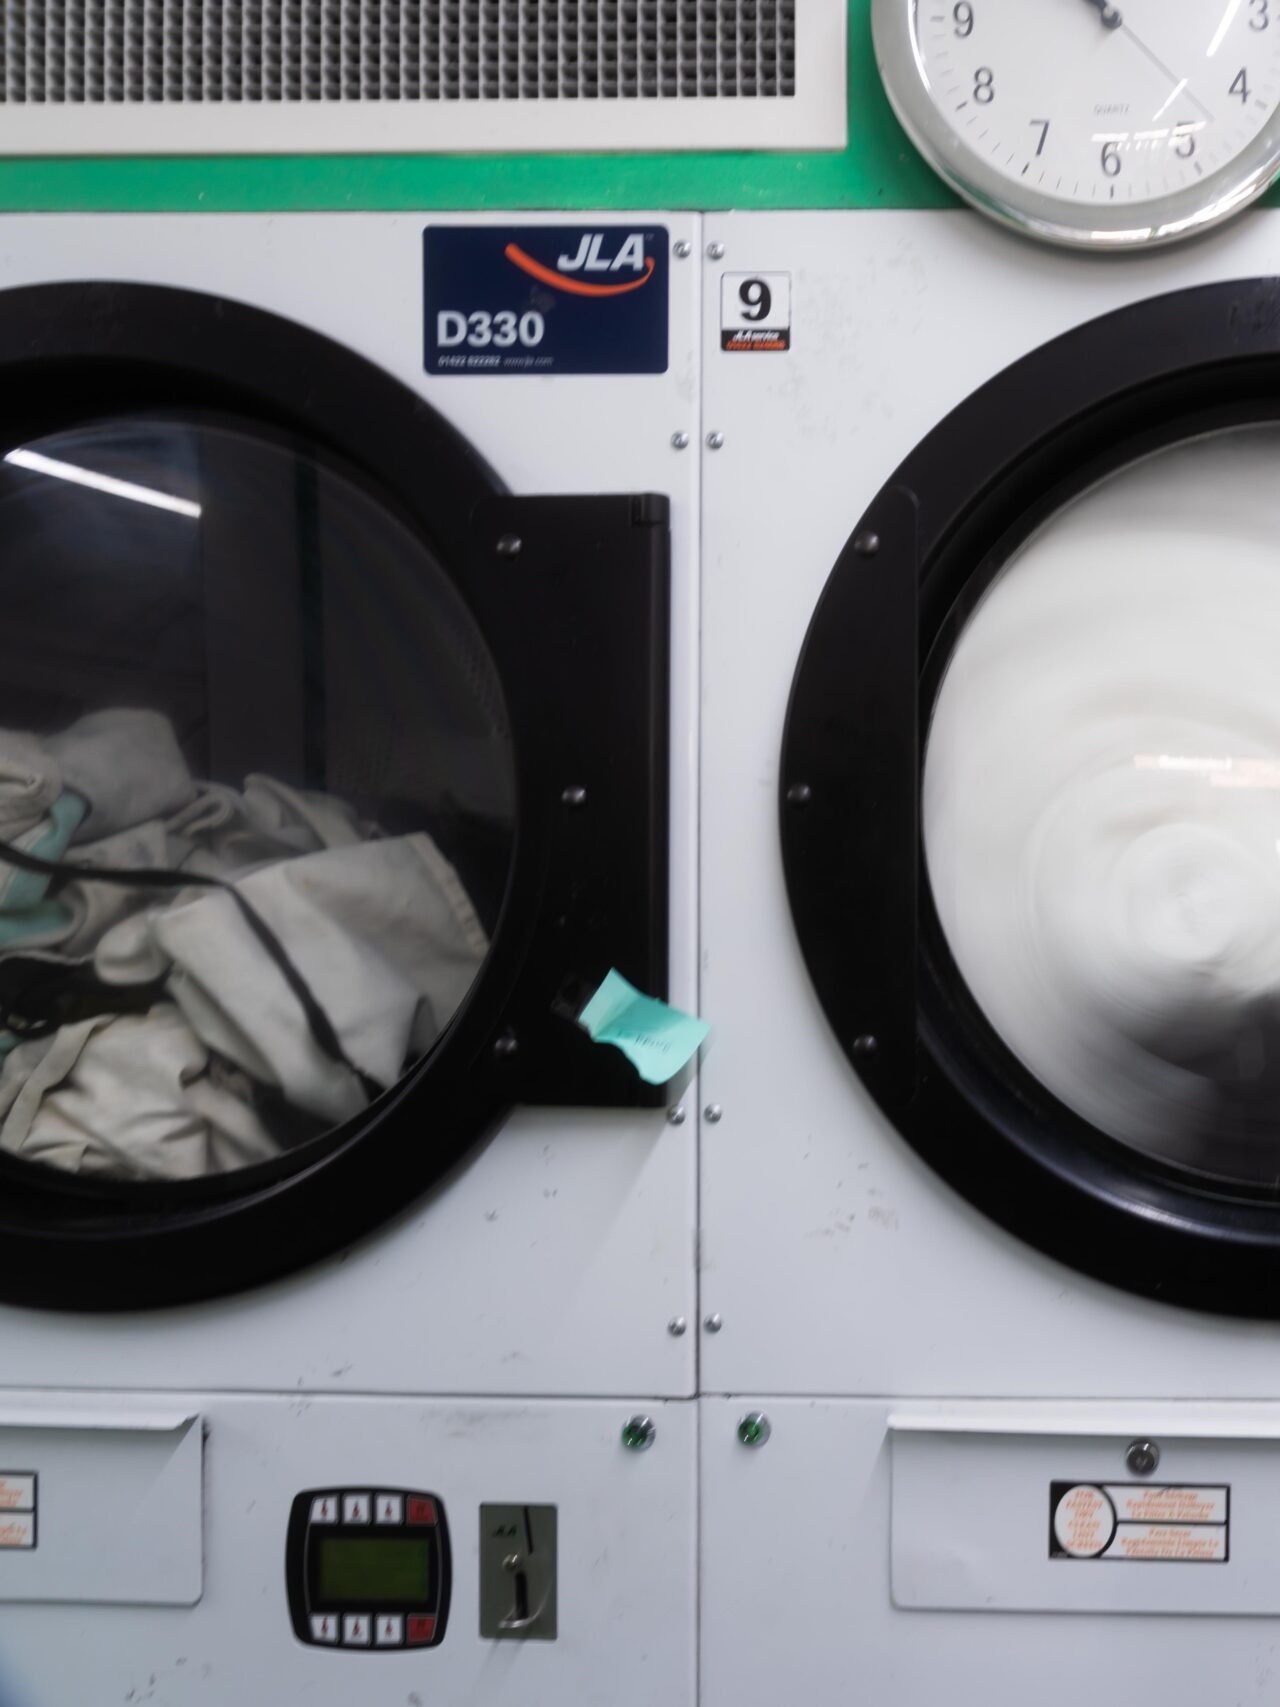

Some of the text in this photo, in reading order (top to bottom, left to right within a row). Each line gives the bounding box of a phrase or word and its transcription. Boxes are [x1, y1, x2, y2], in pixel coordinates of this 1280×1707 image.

[953, 1, 975, 37] 9
[1249, 0, 1268, 31] 3
[973, 66, 994, 104] 8
[1229, 67, 1251, 104] 4
[1030, 119, 1051, 158] 7
[1174, 122, 1195, 158] 5
[1100, 141, 1121, 177] 6
[557, 233, 645, 272] JLA
[738, 279, 771, 322] 9
[436, 310, 545, 347] D330
